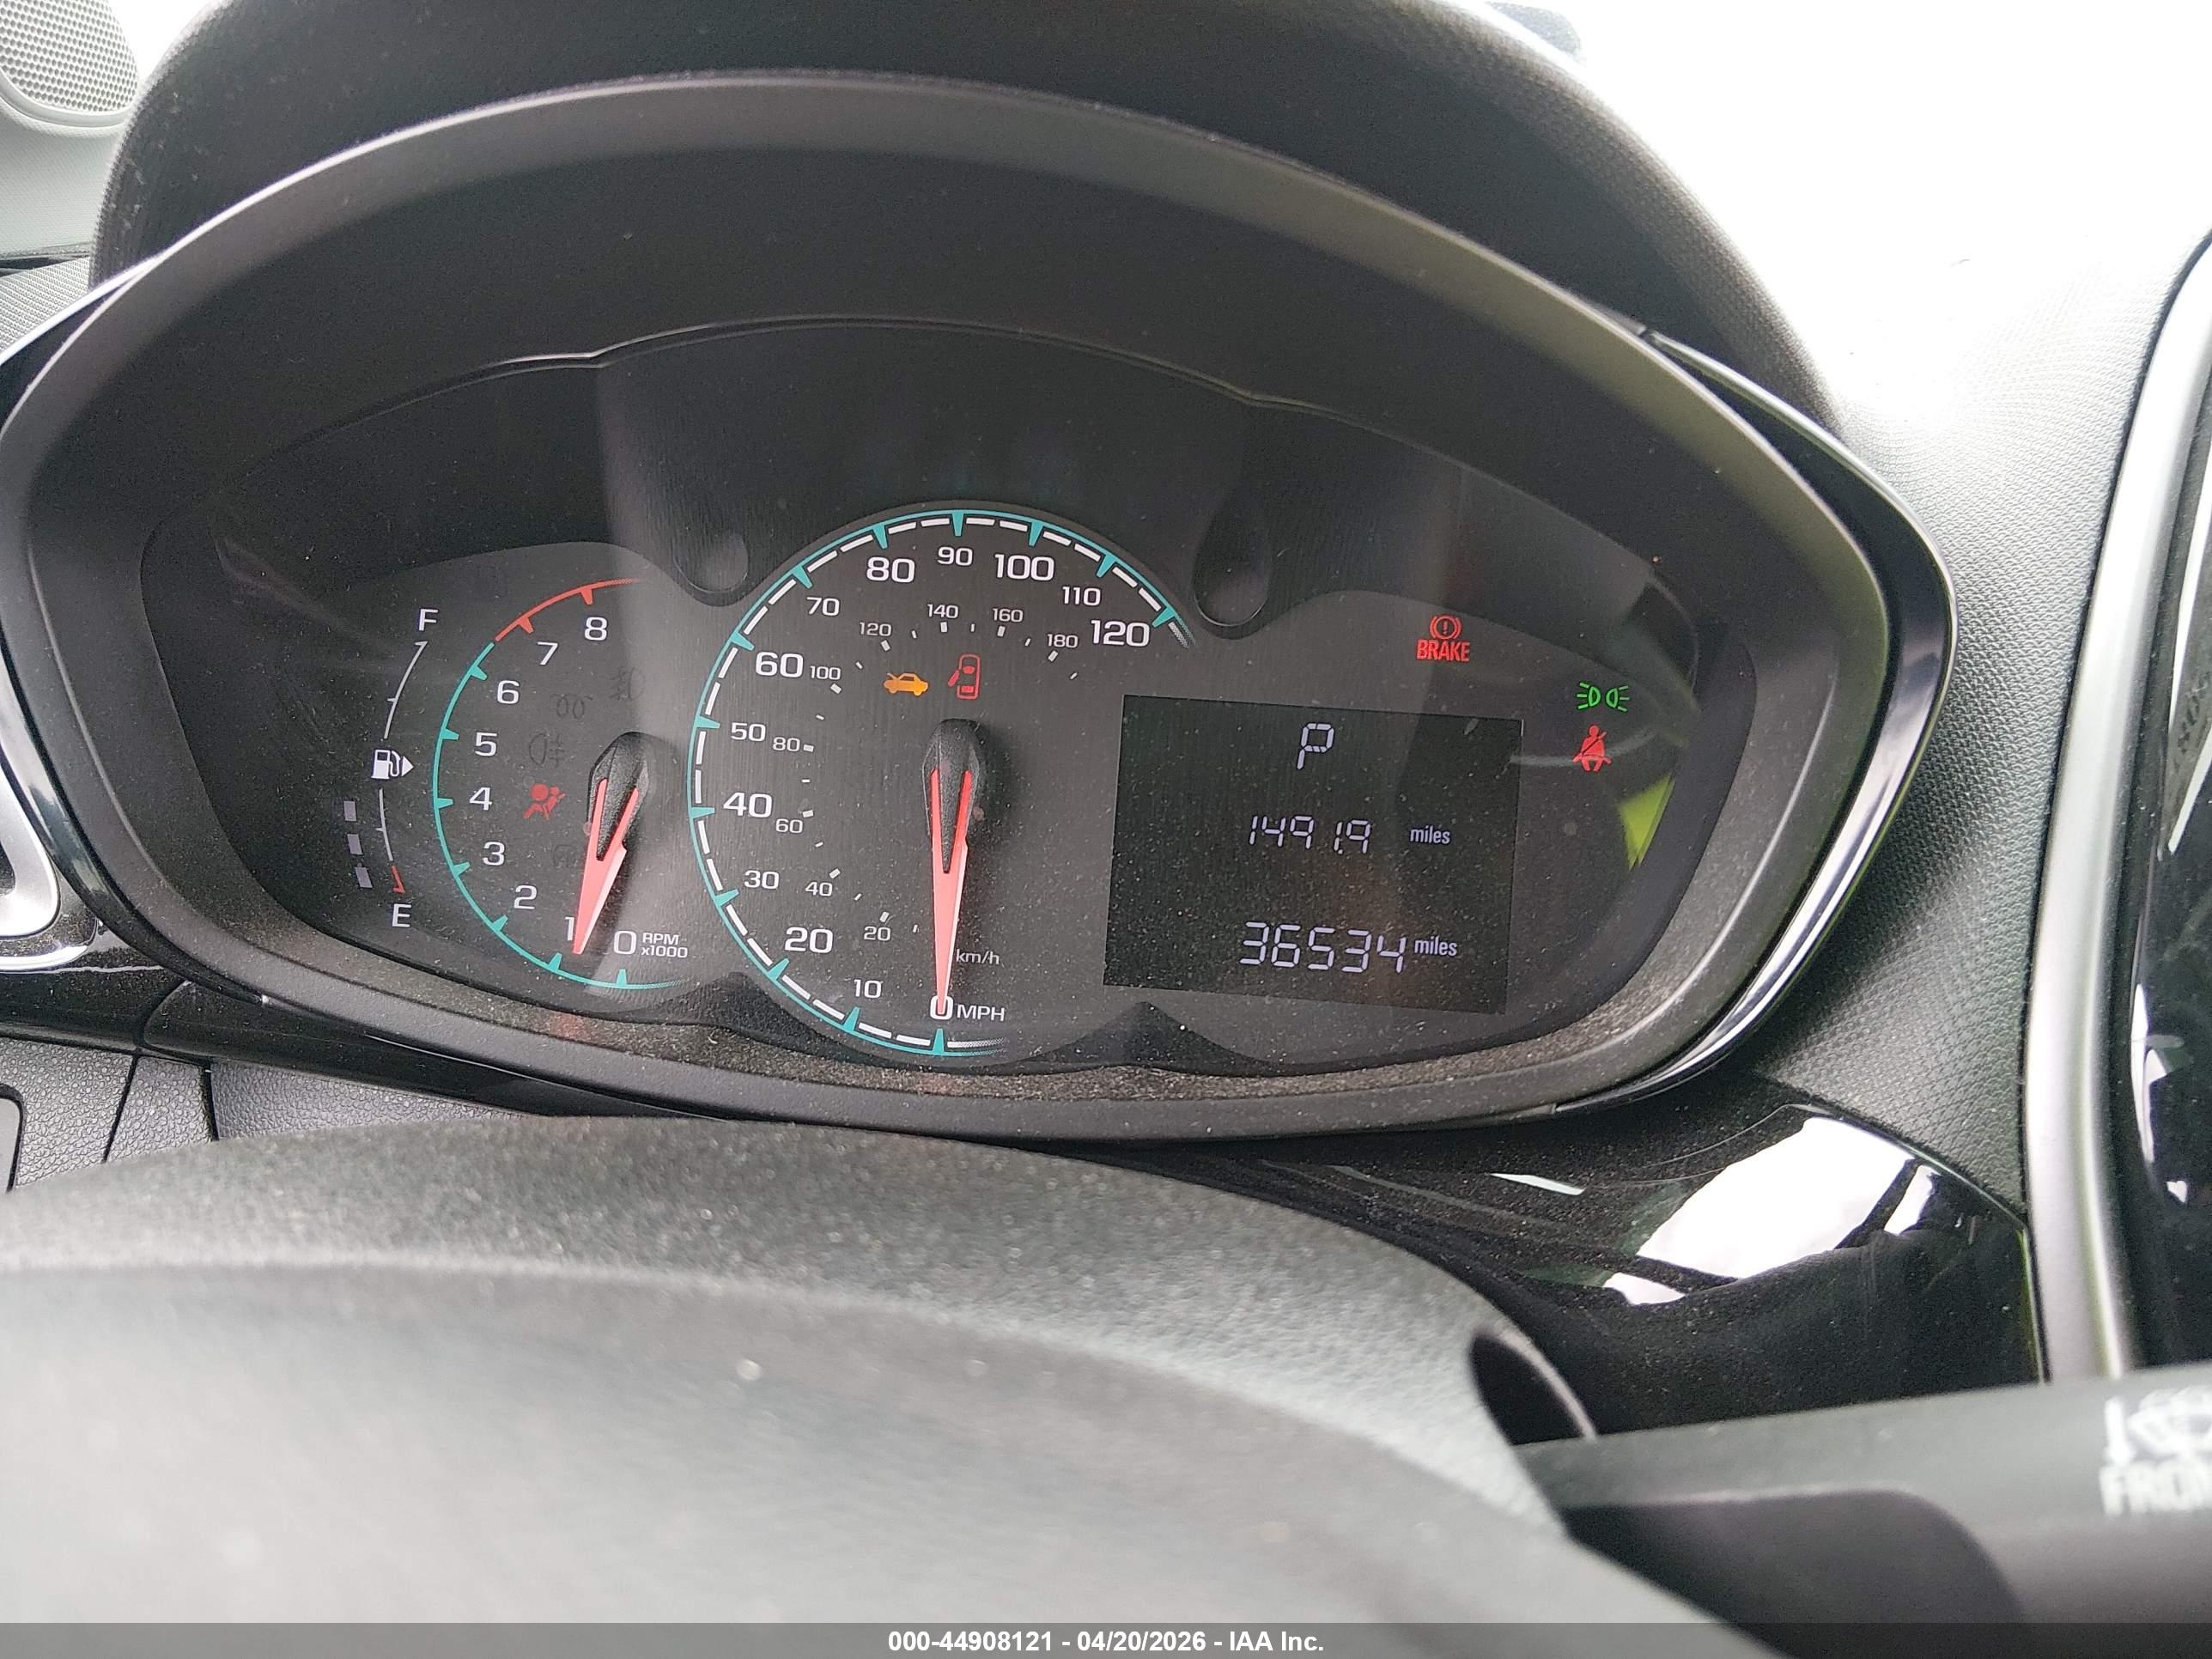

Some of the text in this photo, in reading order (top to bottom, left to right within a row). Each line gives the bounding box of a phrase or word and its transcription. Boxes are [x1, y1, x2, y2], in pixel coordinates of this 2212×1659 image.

[936, 545, 974, 567] 90
[994, 552, 1055, 581] 100
[866, 556, 916, 583] 80
[805, 596, 841, 617] 70
[1061, 586, 1101, 606] 110
[418, 608, 439, 631] F
[927, 603, 959, 619] 140
[992, 607, 1024, 623] 160
[585, 617, 608, 641] 8
[859, 621, 892, 637] 120
[1046, 631, 1079, 648] 180
[1090, 619, 1150, 647] 120
[537, 641, 558, 665] 7
[1416, 639, 1471, 662] BRAKE
[755, 653, 804, 678] 60
[810, 665, 841, 681] 100
[497, 680, 520, 704] 6
[475, 732, 499, 756] 5
[730, 722, 766, 743] 50
[773, 737, 800, 752] 80
[1297, 723, 1335, 770] P
[469, 787, 493, 811] 4
[723, 792, 773, 818] 40
[775, 818, 803, 834] 60
[1410, 824, 1451, 845] miles
[483, 842, 507, 866] 3
[744, 870, 780, 890] 30
[805, 881, 833, 897] 40
[514, 885, 538, 910] 2
[392, 904, 411, 928] E
[564, 916, 575, 941] 1
[864, 926, 891, 942] 20
[613, 930, 679, 955] 0 RPM
[641, 945, 689, 959] x1000
[784, 927, 833, 954] 20
[1239, 921, 1457, 974] 36534 miles
[956, 948, 1000, 965] km/h
[854, 980, 882, 999] 10
[930, 995, 1005, 1022] 0 MPH
